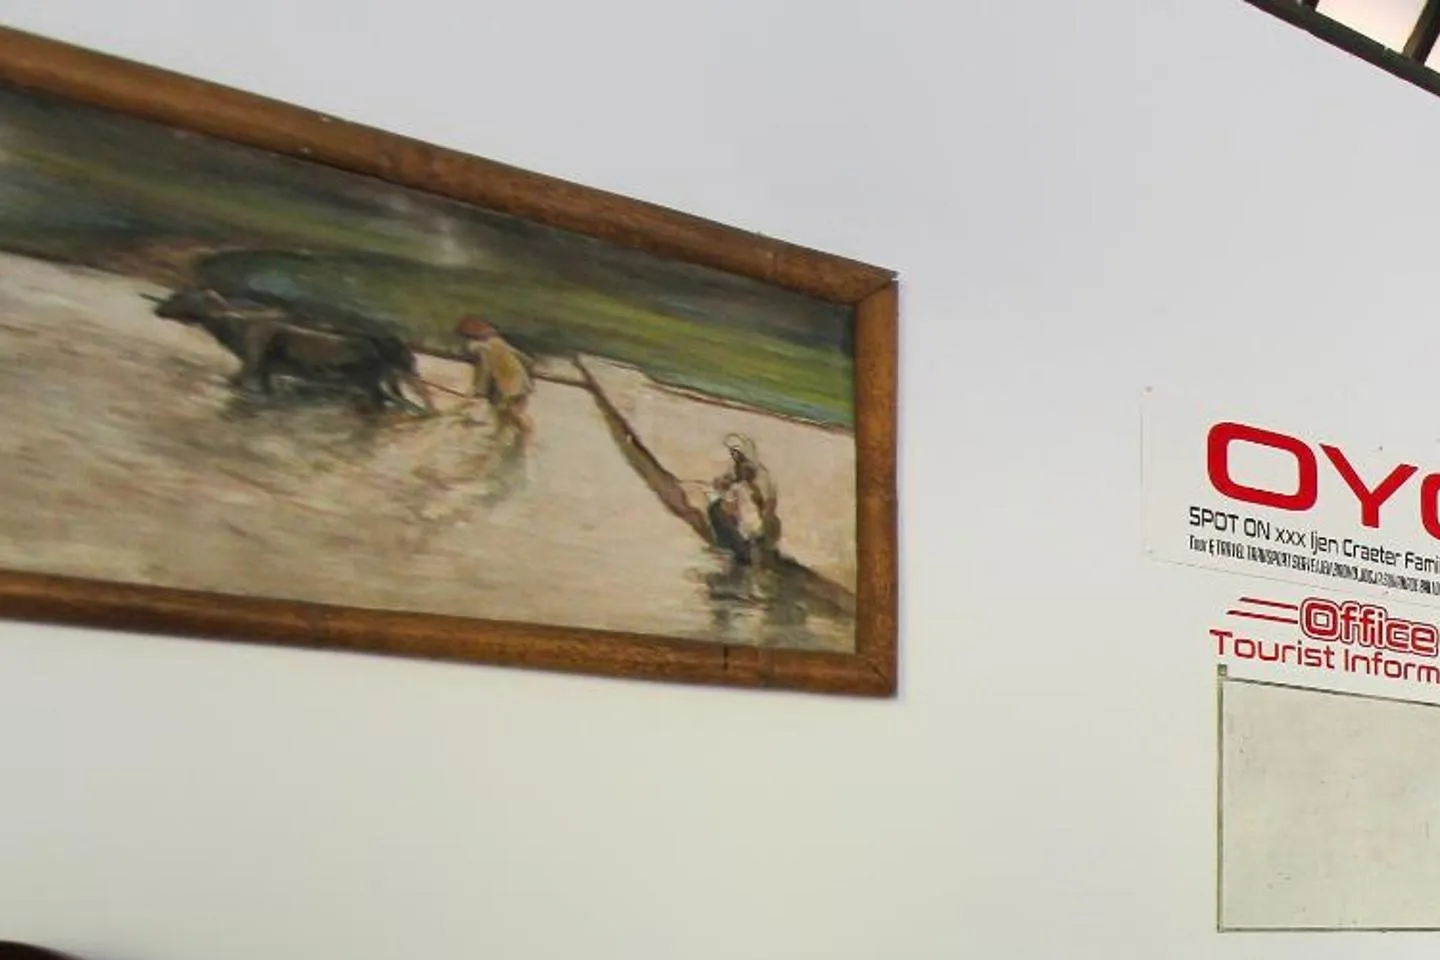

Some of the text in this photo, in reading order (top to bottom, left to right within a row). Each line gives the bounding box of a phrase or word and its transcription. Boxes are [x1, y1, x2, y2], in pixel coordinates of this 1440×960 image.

[1189, 506, 1239, 533] SPOT
[1244, 518, 1271, 540] ON
[1311, 531, 1339, 556] Ijen
[1343, 539, 1402, 566] Craeter
[1210, 629, 1335, 669] Tourist
[1303, 599, 1438, 655] Office
